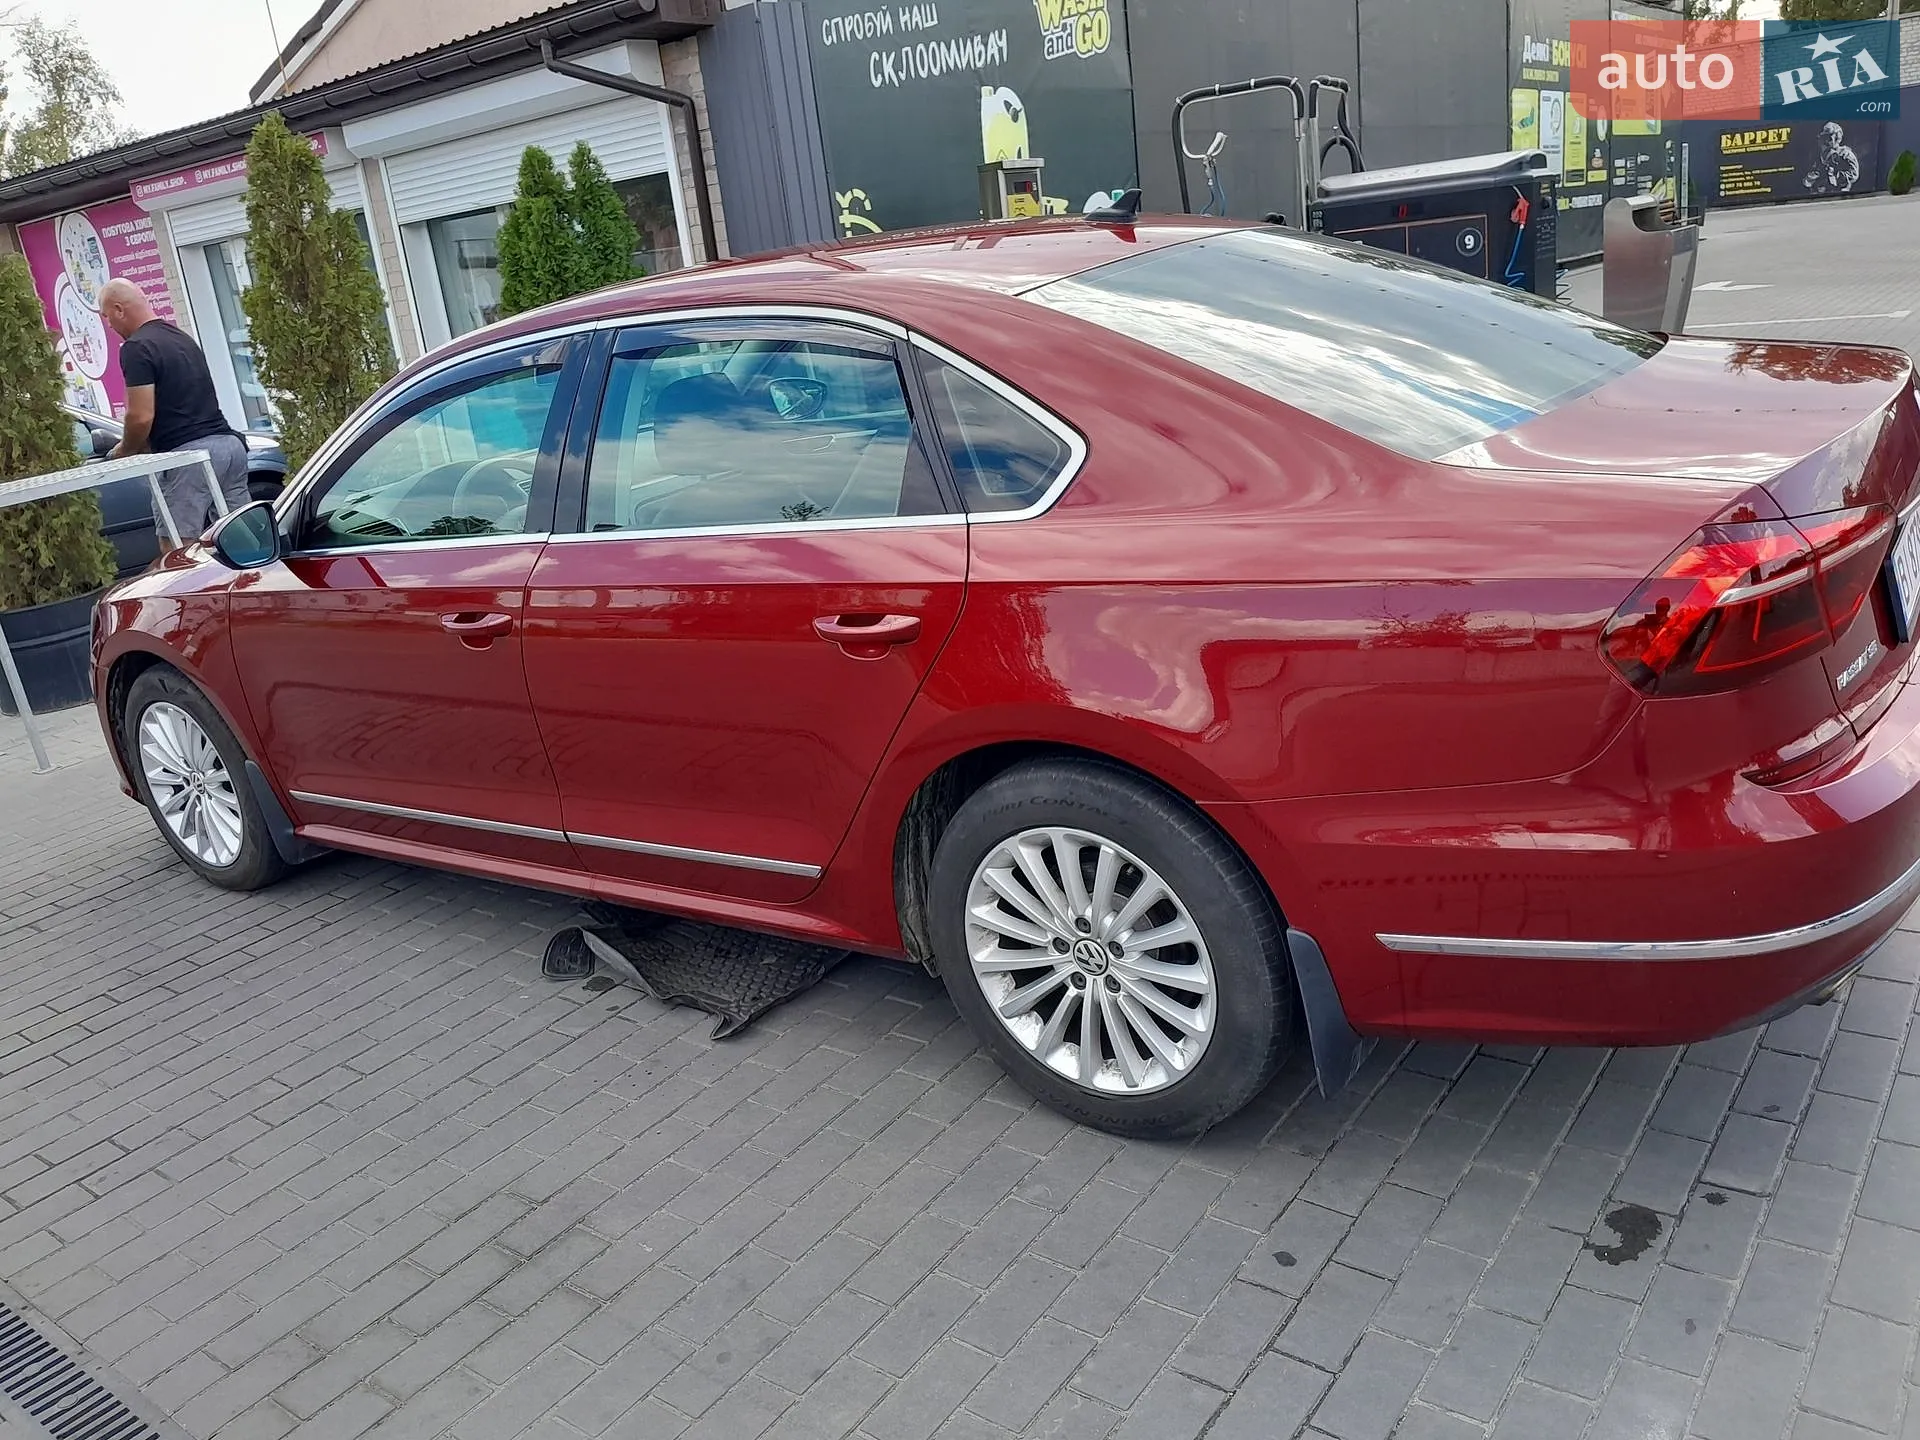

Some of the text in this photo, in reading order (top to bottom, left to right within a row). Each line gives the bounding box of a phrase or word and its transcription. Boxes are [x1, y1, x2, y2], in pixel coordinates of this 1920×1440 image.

[822, 2, 938, 46] СПРОБУЙ НАШ
[1045, 9, 1109, 57] and GO
[869, 28, 1008, 88] СКЛООМИВАЧ
[1721, 127, 1791, 147] БАРРЕТ
[1464, 235, 1475, 249] 9
